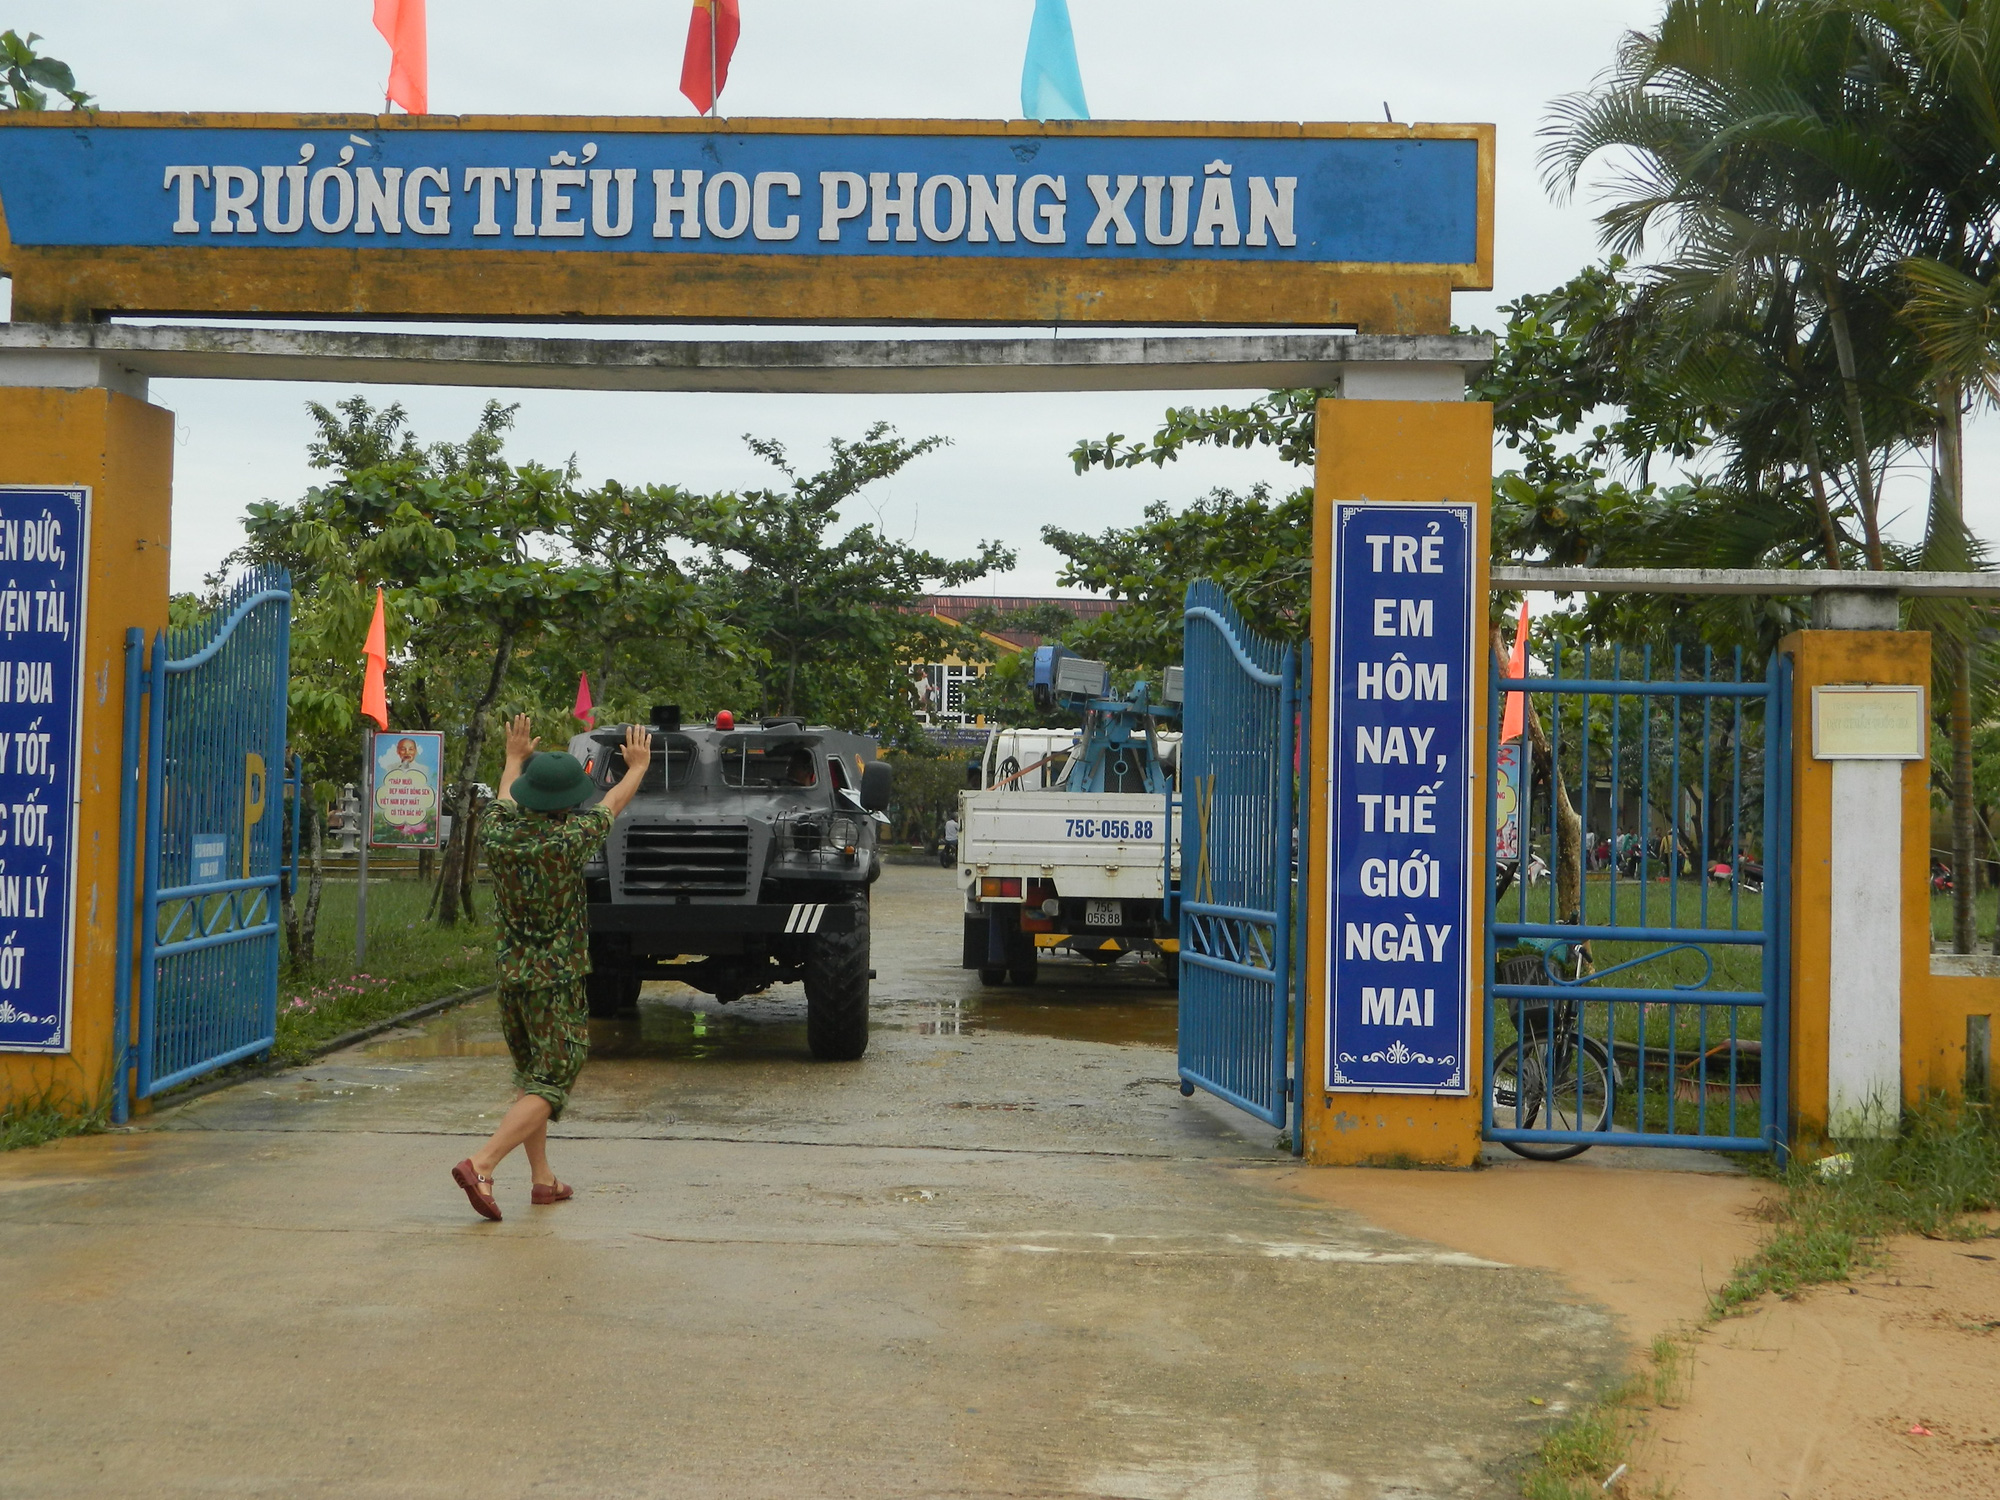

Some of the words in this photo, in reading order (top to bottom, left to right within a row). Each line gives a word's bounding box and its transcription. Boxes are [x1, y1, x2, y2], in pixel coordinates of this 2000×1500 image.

[817, 170, 1067, 245] PHONG
[1086, 159, 1298, 247] XUÂN
[23, 508, 66, 571] ĐỨC,
[1365, 521, 1445, 574] TRẺ
[36, 580, 70, 642] TÀI,
[1373, 599, 1434, 637] EM
[16, 661, 53, 704] ĐUA
[1357, 652, 1448, 701] HÔM
[15, 716, 56, 785] TỐT,
[1356, 726, 1448, 774] NAY,
[12, 787, 53, 856] TỐT,
[1065, 819, 1153, 839] 75C-056.88
[1357, 780, 1445, 834] THẾ
[25, 864, 49, 918] LÝ
[1360, 849, 1440, 898] GIỚI
[1087, 912, 1121, 925] 056.88
[1095, 901, 1113, 913] 75C
[1345, 913, 1452, 962] NGÀY
[1361, 986, 1435, 1026] MAI
